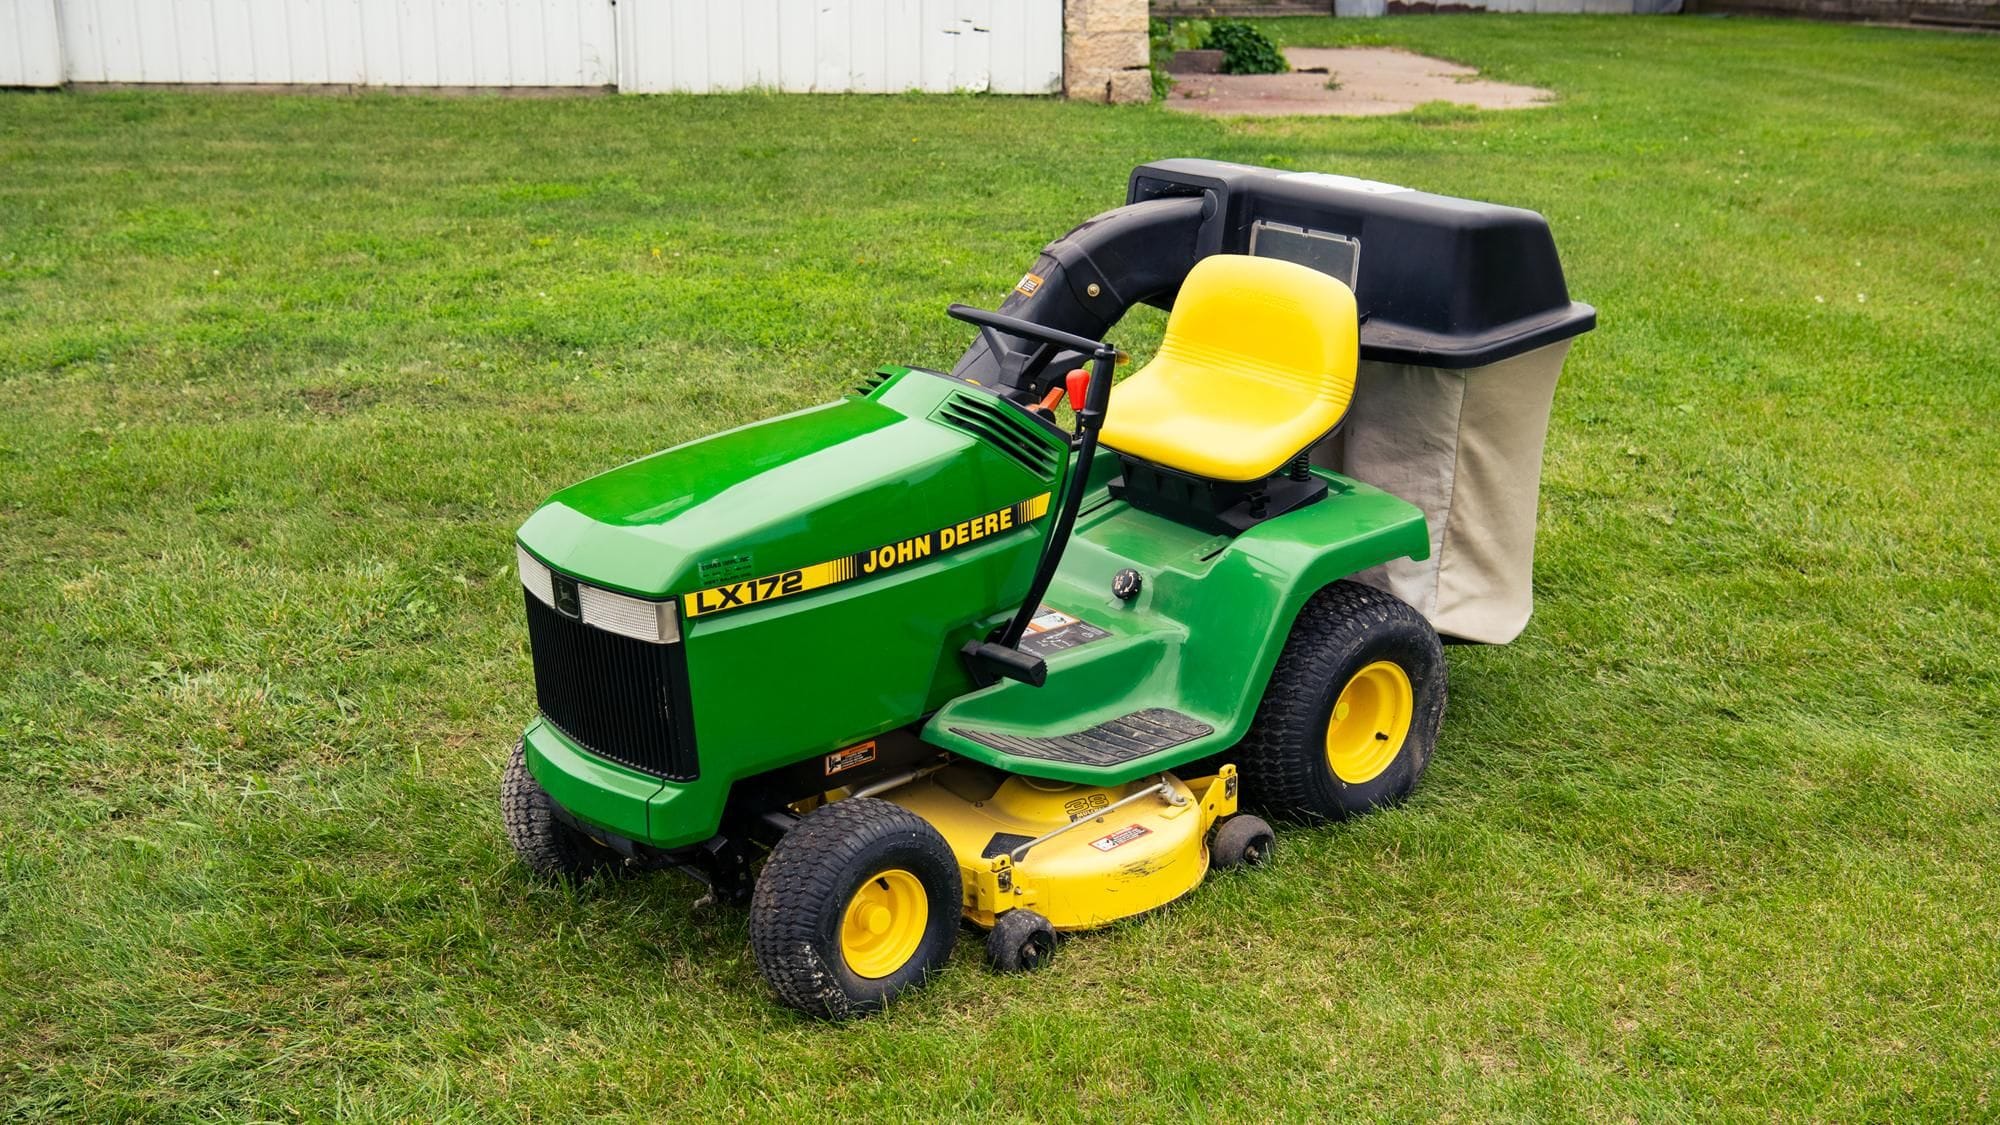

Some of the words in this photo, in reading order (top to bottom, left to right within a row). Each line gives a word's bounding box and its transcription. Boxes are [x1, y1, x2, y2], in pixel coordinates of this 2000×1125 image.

[863, 535, 931, 574] JOHN
[940, 507, 1013, 551] DEERE
[697, 571, 803, 614] LX172
[1064, 794, 1109, 815] 38
